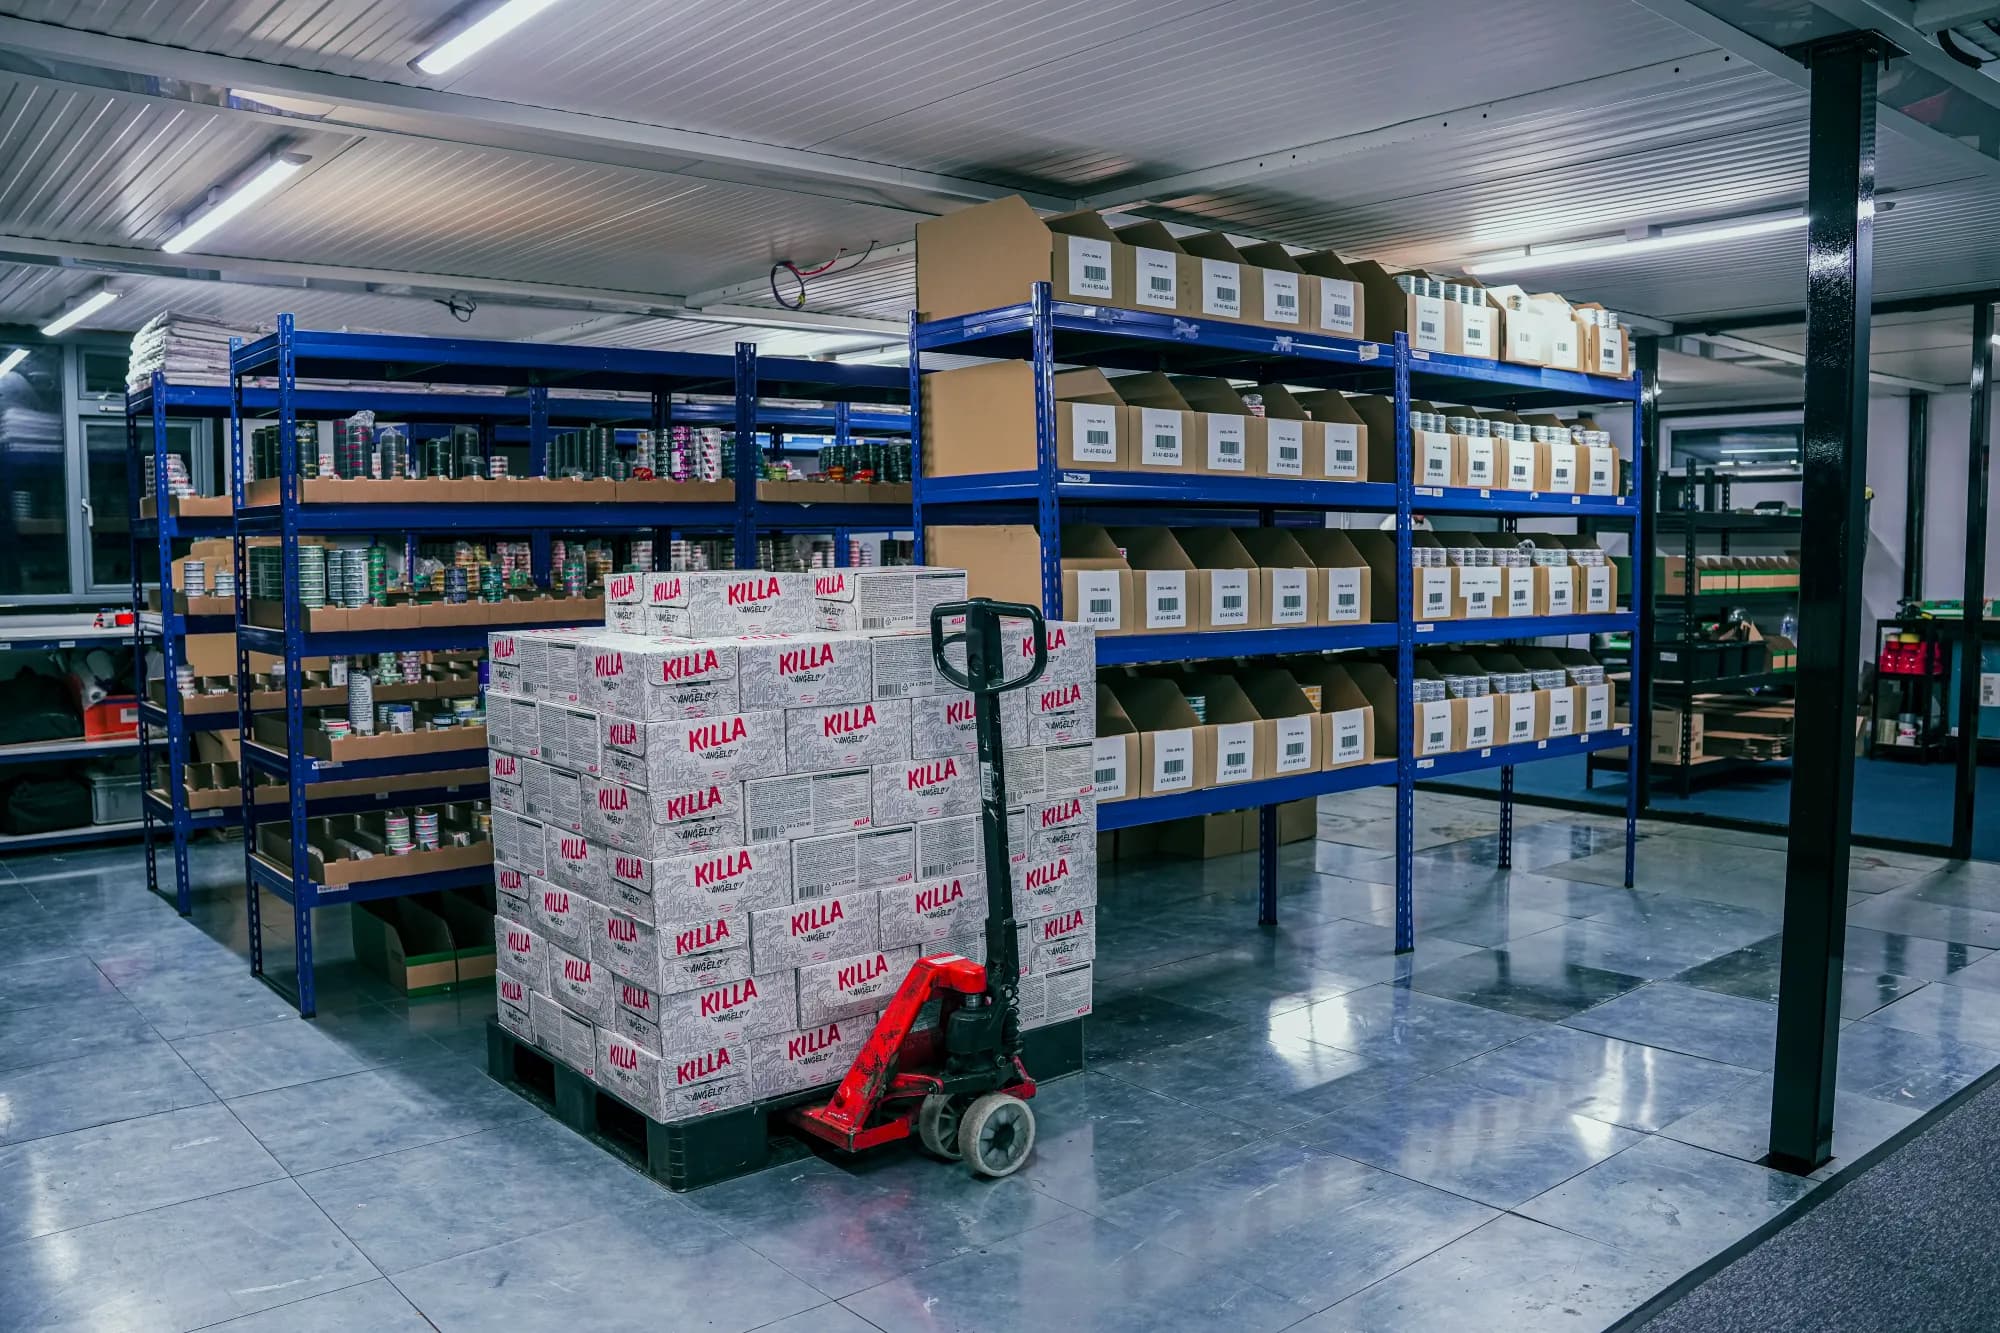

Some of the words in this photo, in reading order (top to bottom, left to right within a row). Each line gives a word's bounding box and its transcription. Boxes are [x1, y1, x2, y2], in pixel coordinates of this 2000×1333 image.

[610, 576, 635, 599] KILLA
[654, 578, 681, 601] KILLA
[728, 577, 781, 606] KILLA
[816, 575, 845, 594] KILLA
[495, 640, 514, 657] KILLA
[779, 643, 834, 676] KILLA
[595, 653, 623, 676] KILLA
[663, 649, 719, 682] KILLA
[677, 691, 711, 704] ANGELS
[1041, 684, 1081, 711] KILLA
[824, 705, 876, 736] KILLA
[610, 724, 636, 744] KILLA
[689, 717, 746, 752] KILLA
[496, 758, 515, 775] KILLA
[706, 750, 733, 760] ANGELS
[908, 758, 957, 791] KILLA
[599, 789, 628, 810] KILLA
[667, 786, 722, 820] KILLA
[853, 816, 870, 827] KILLA
[1042, 799, 1082, 827] KILLA
[682, 828, 715, 839] ANGELS
[561, 840, 587, 860] KILLA
[500, 872, 521, 888] KILLA
[617, 859, 642, 878] KILLA
[695, 850, 752, 887] KILLA
[1026, 859, 1068, 890] KILLA
[712, 882, 739, 893] ANGELS
[916, 879, 963, 913] KILLA
[544, 893, 569, 912] KILLA
[791, 900, 844, 936] KILLA
[1045, 910, 1083, 939] KILLA
[508, 932, 530, 952] KILLA
[608, 920, 636, 941] KILLA
[676, 920, 729, 955] KILLA
[807, 931, 832, 942] ANGELS
[565, 961, 591, 982] KILLA
[691, 959, 724, 973] ANGELS
[838, 954, 888, 991] KILLA
[502, 982, 522, 1000] KILLA
[623, 986, 649, 1009] KILLA
[701, 978, 758, 1017] KILLA
[718, 1011, 745, 1023] ANGELS
[788, 1024, 841, 1061] KILLA
[610, 1045, 637, 1070] KILLA
[678, 1048, 730, 1085] KILLA
[804, 1053, 829, 1065] ANGELS
[692, 1086, 725, 1100] ANGELS
